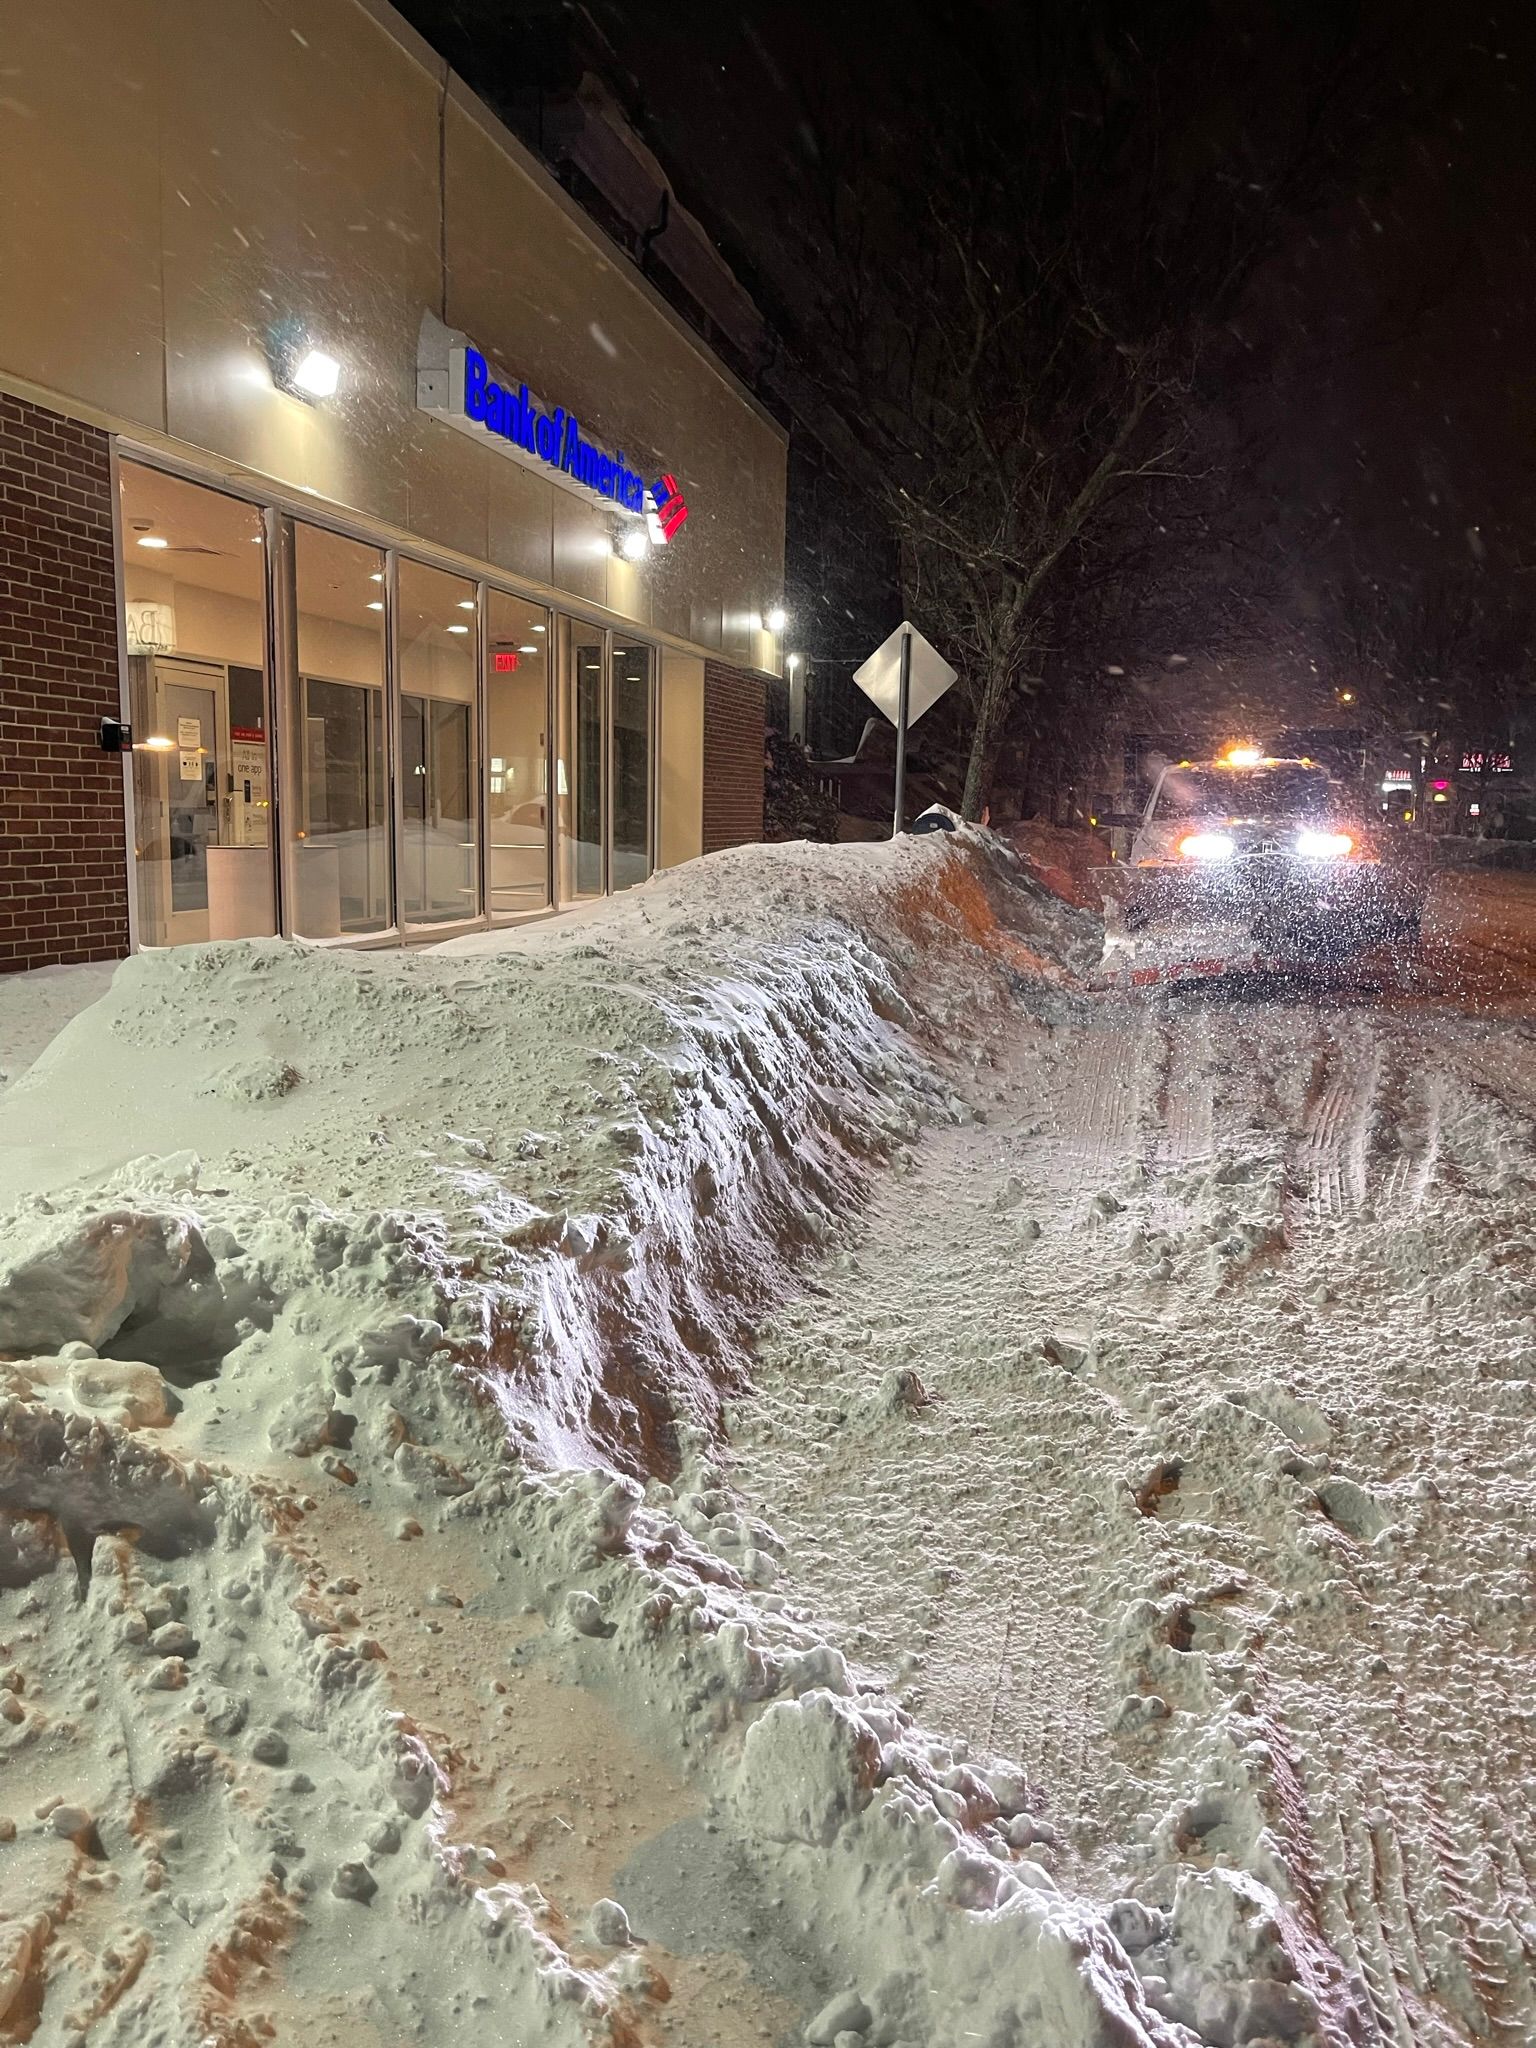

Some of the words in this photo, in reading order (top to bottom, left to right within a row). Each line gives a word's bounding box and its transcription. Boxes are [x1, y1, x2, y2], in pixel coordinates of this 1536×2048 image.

[465, 346, 536, 454] Bank
[536, 407, 565, 467] of
[561, 416, 644, 514] America
[495, 654, 516, 672] EXIT
[250, 765, 262, 776] app
